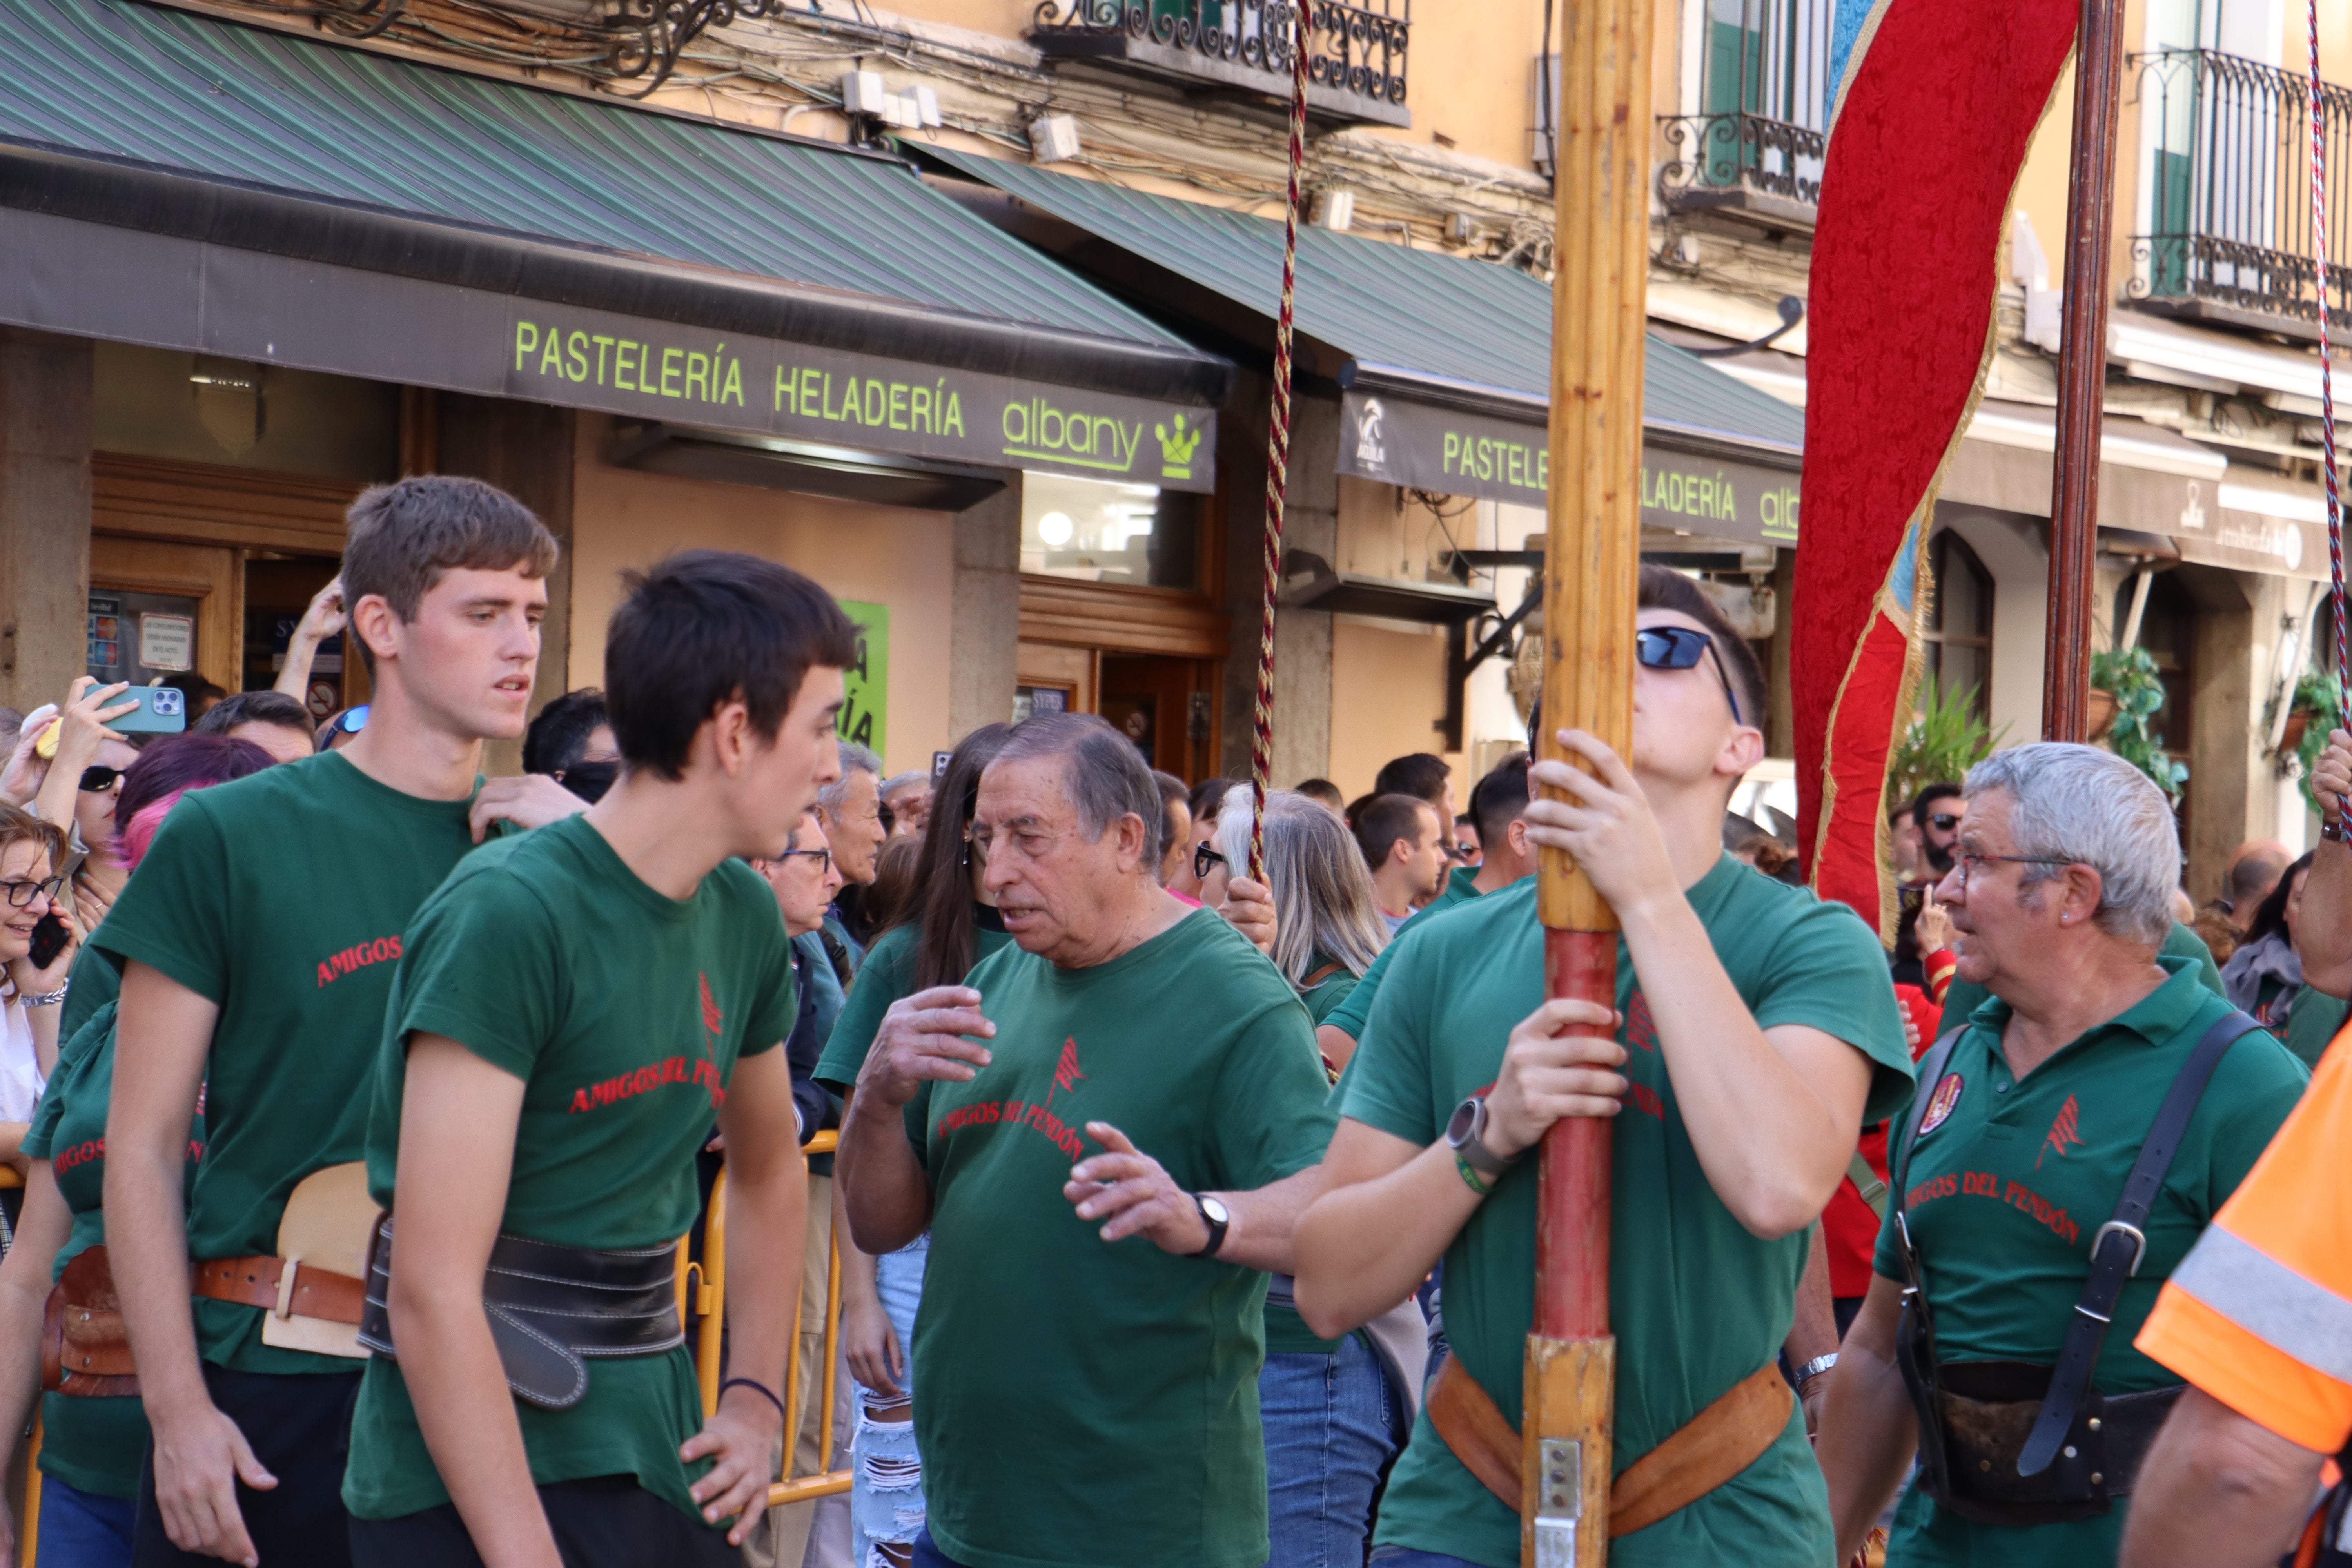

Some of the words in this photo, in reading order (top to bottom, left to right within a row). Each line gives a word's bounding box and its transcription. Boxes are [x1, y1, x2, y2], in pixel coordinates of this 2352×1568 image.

[515, 321, 745, 407] PASTELERÍA
[775, 365, 965, 438] HELADERÍA
[1002, 397, 1143, 471] albany
[1443, 432, 1549, 490] PASTELE
[1639, 468, 1737, 522] LADERÍA
[318, 935, 403, 989] AMIGOS
[568, 1063, 659, 1114] AMIGOS
[938, 1101, 1000, 1142] AMIGOS
[1024, 1104, 1085, 1163] PENDÓN
[1962, 1171, 2000, 1198] DEL
[2004, 1180, 2080, 1246] PENDÓN
